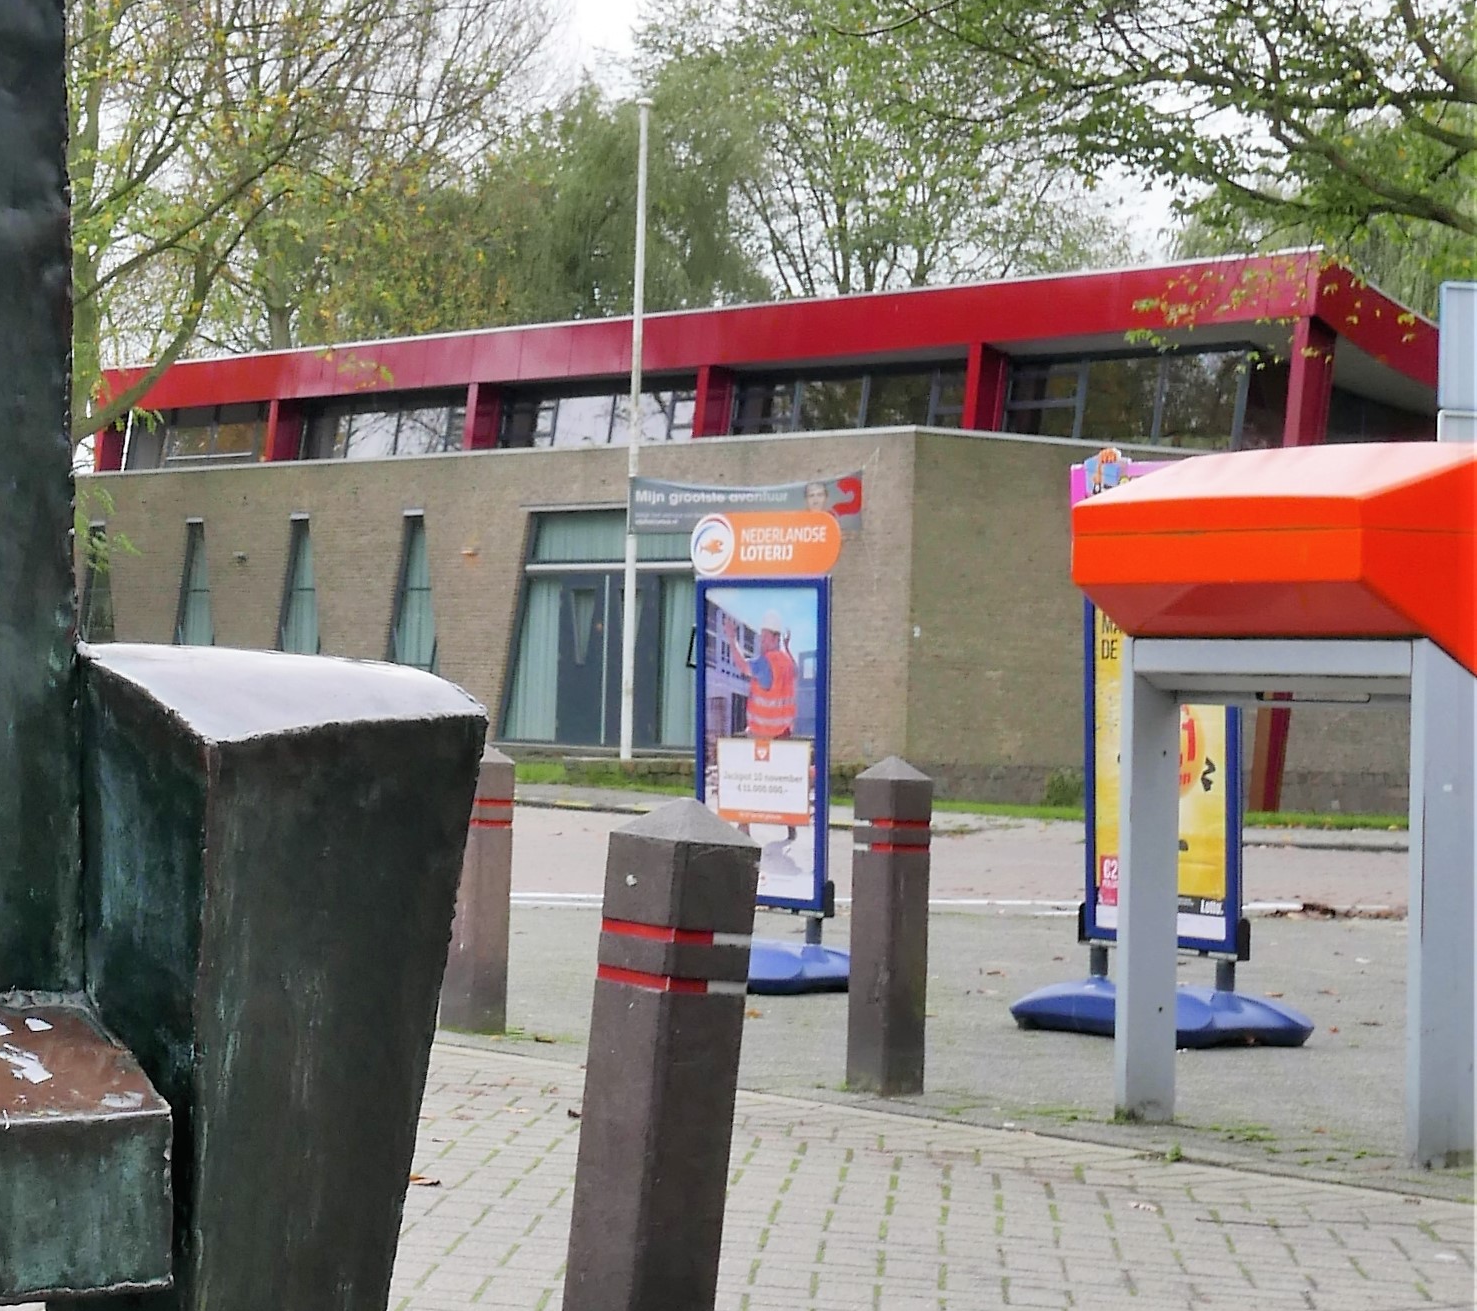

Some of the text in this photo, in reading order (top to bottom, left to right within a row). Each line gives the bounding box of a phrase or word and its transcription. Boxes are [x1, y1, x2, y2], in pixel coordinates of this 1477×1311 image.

[634, 490, 789, 506] Mijn grootste avontuur
[741, 526, 827, 544] NEDERLANDSE
[740, 544, 793, 562] LOTERIJ
[1101, 639, 1118, 660] DE
[724, 771, 752, 782] Jackpot
[764, 774, 803, 783] november
